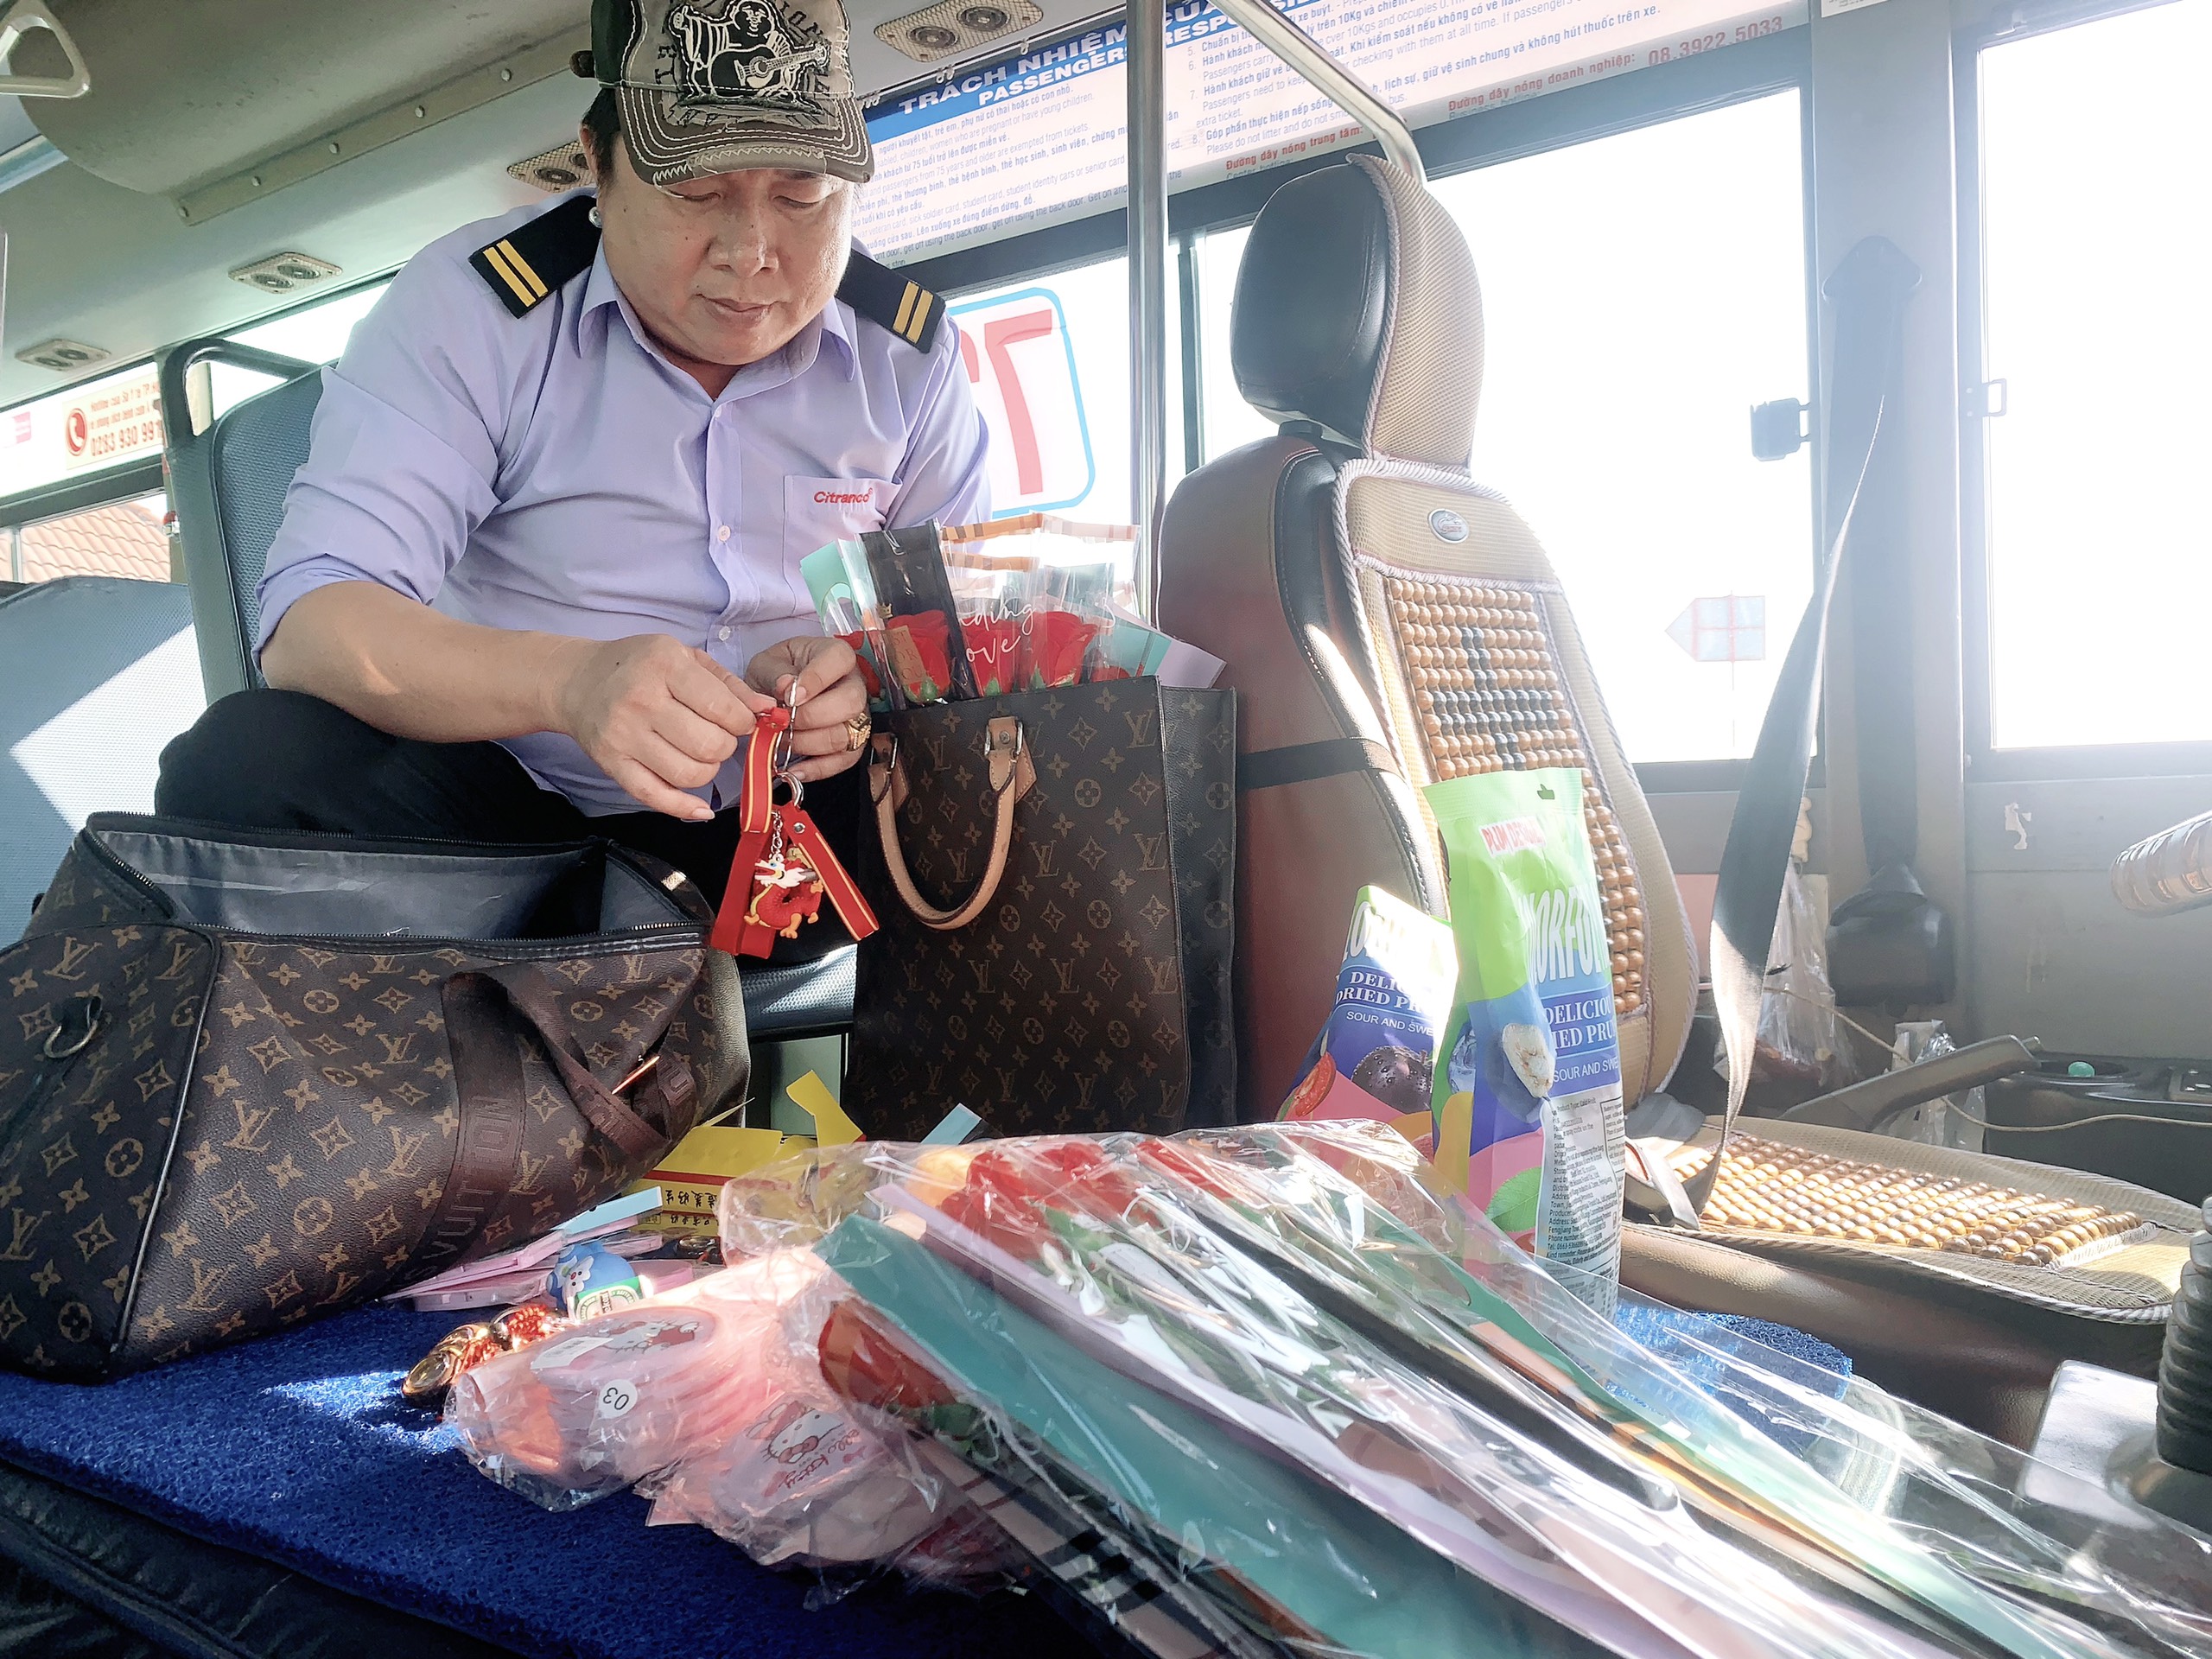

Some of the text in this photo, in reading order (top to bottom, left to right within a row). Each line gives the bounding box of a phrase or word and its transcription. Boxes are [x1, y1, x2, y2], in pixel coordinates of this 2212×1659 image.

[1338, 10, 1362, 25] 10Kg
[1351, 40, 1365, 52] Khi
[1394, 24, 1415, 41] soát
[1439, 10, 1469, 26] không
[1471, 5, 1483, 19] có
[1377, 16, 1395, 29] and
[1384, 75, 1402, 91] lịch
[1455, 55, 1477, 70] sinh
[1479, 46, 1510, 64] chung
[1513, 41, 1525, 54] và
[1529, 33, 1560, 50] không
[1564, 24, 1581, 39] hút
[1584, 15, 1615, 33] thuốc
[1618, 10, 1640, 24] trên
[1397, 41, 1417, 54] with
[1420, 32, 1444, 48] them
[1203, 53, 1225, 67] Hành
[1227, 44, 1257, 59] khách
[978, 47, 1127, 105] PASSENGER
[1203, 61, 1251, 80] Passengers
[899, 66, 1007, 115] TRÁCH
[1204, 82, 1227, 96] Hành
[1229, 73, 1255, 89] khách
[1490, 87, 1510, 101] dây
[1515, 78, 1542, 93] nóng
[1548, 67, 1584, 85] doanh
[996, 103, 1010, 115] thai
[1012, 99, 1029, 111] hoặc
[1041, 91, 1055, 102] con
[1203, 91, 1251, 111] Passengers
[1254, 85, 1274, 97] need
[1206, 126, 1224, 141] Góp
[1270, 109, 1290, 124] hiện
[1235, 137, 1246, 147] do
[1248, 134, 1261, 144] not
[1284, 123, 1300, 136] and
[1302, 118, 1313, 129] do
[1314, 114, 1328, 124] not
[1052, 142, 1067, 156] sinh
[1282, 141, 1306, 156] nóng
[1310, 134, 1336, 148] trung
[913, 159, 921, 169] 75
[937, 167, 945, 175] 75
[813, 490, 870, 504] Citranco
[1346, 1011, 1379, 1025] SOUR
[1381, 1017, 1406, 1030] AND
[1545, 995, 1611, 1026] DELICIOU
[1554, 1066, 1580, 1083] SOUR
[1582, 1062, 1600, 1077] AND
[603, 1388, 629, 1410] 03
